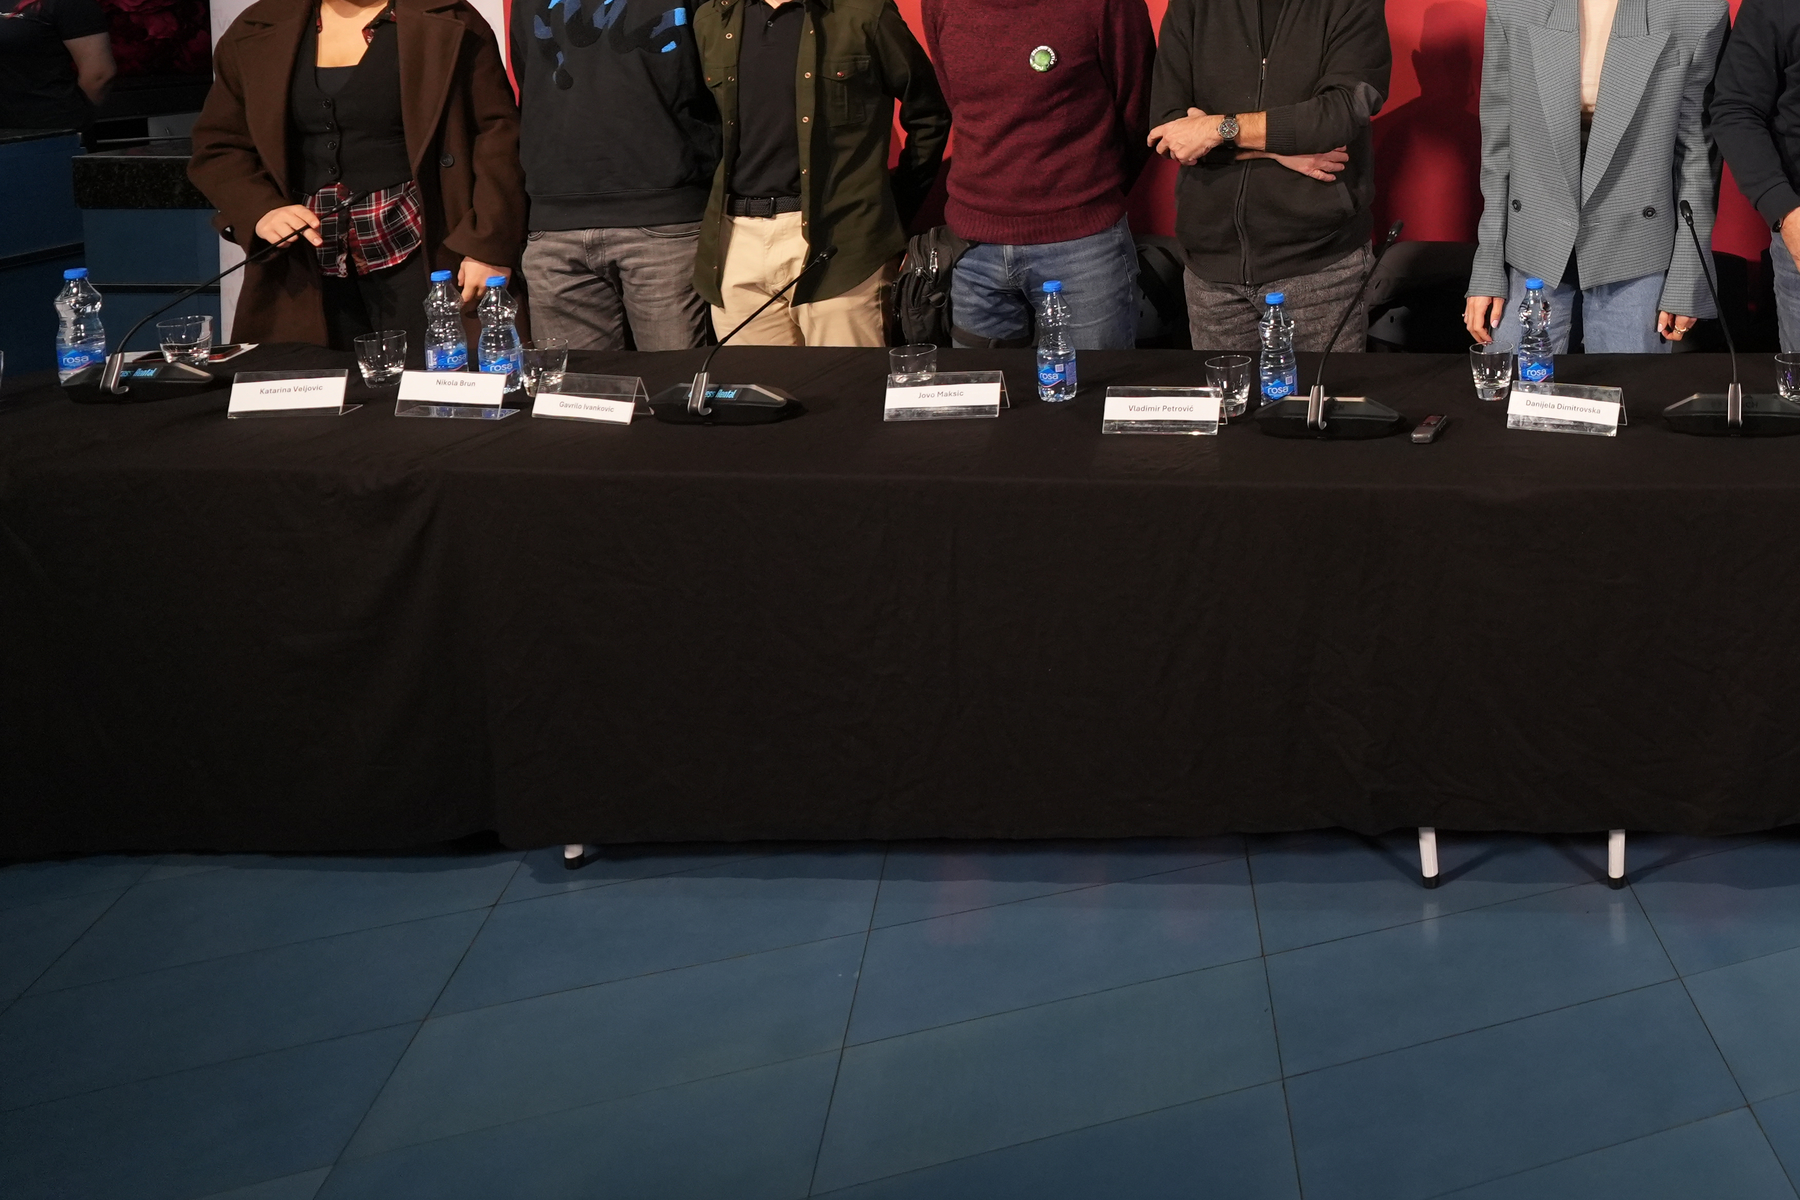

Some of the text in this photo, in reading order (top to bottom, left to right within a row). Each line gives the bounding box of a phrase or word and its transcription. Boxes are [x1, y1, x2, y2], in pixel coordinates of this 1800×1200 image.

[62, 355, 89, 364] rosa
[447, 353, 466, 364] rosa
[490, 362, 513, 371] rosa
[1040, 372, 1059, 380] rosa
[1527, 367, 1546, 377] rosa
[259, 385, 323, 394] Katarina Veljovic
[937, 390, 964, 398] Maksic
[1267, 385, 1289, 394] rosa
[559, 401, 582, 409] Gavrilo
[1525, 400, 1601, 414] Danijela Dimitrovska
